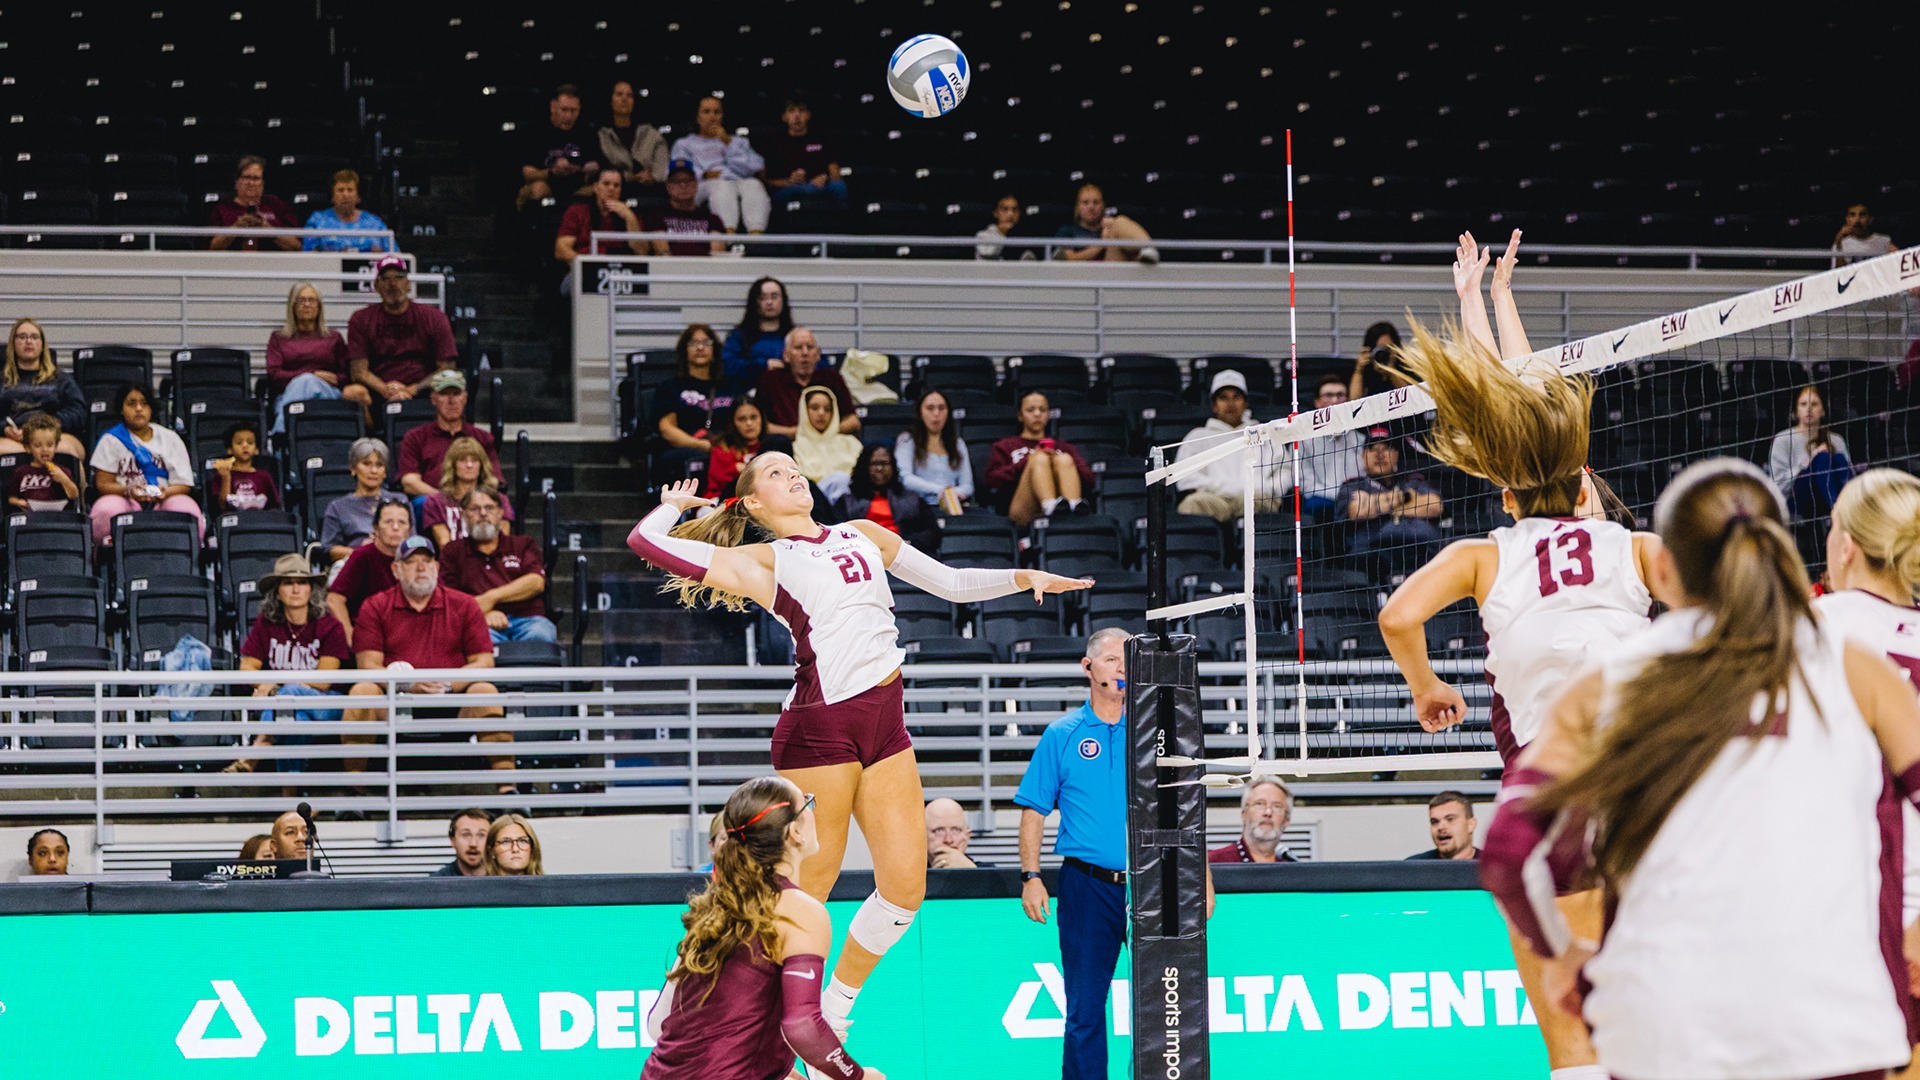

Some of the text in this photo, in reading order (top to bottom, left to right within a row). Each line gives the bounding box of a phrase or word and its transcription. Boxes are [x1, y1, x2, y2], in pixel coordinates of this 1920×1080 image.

[1900, 250, 1920, 273] EK
[1774, 282, 1803, 307] EKU
[1661, 313, 1688, 336] EKU
[1560, 341, 1585, 362] EKU
[1388, 387, 1408, 407] EKU
[1312, 407, 1332, 426] EKU
[569, 533, 582, 551] E
[831, 551, 872, 584] 21
[1535, 528, 1594, 597] 13
[598, 593, 611, 611] D
[1161, 967, 1181, 1026] sports
[1336, 970, 1538, 1030] DENT
[294, 992, 523, 1056] DELTA
